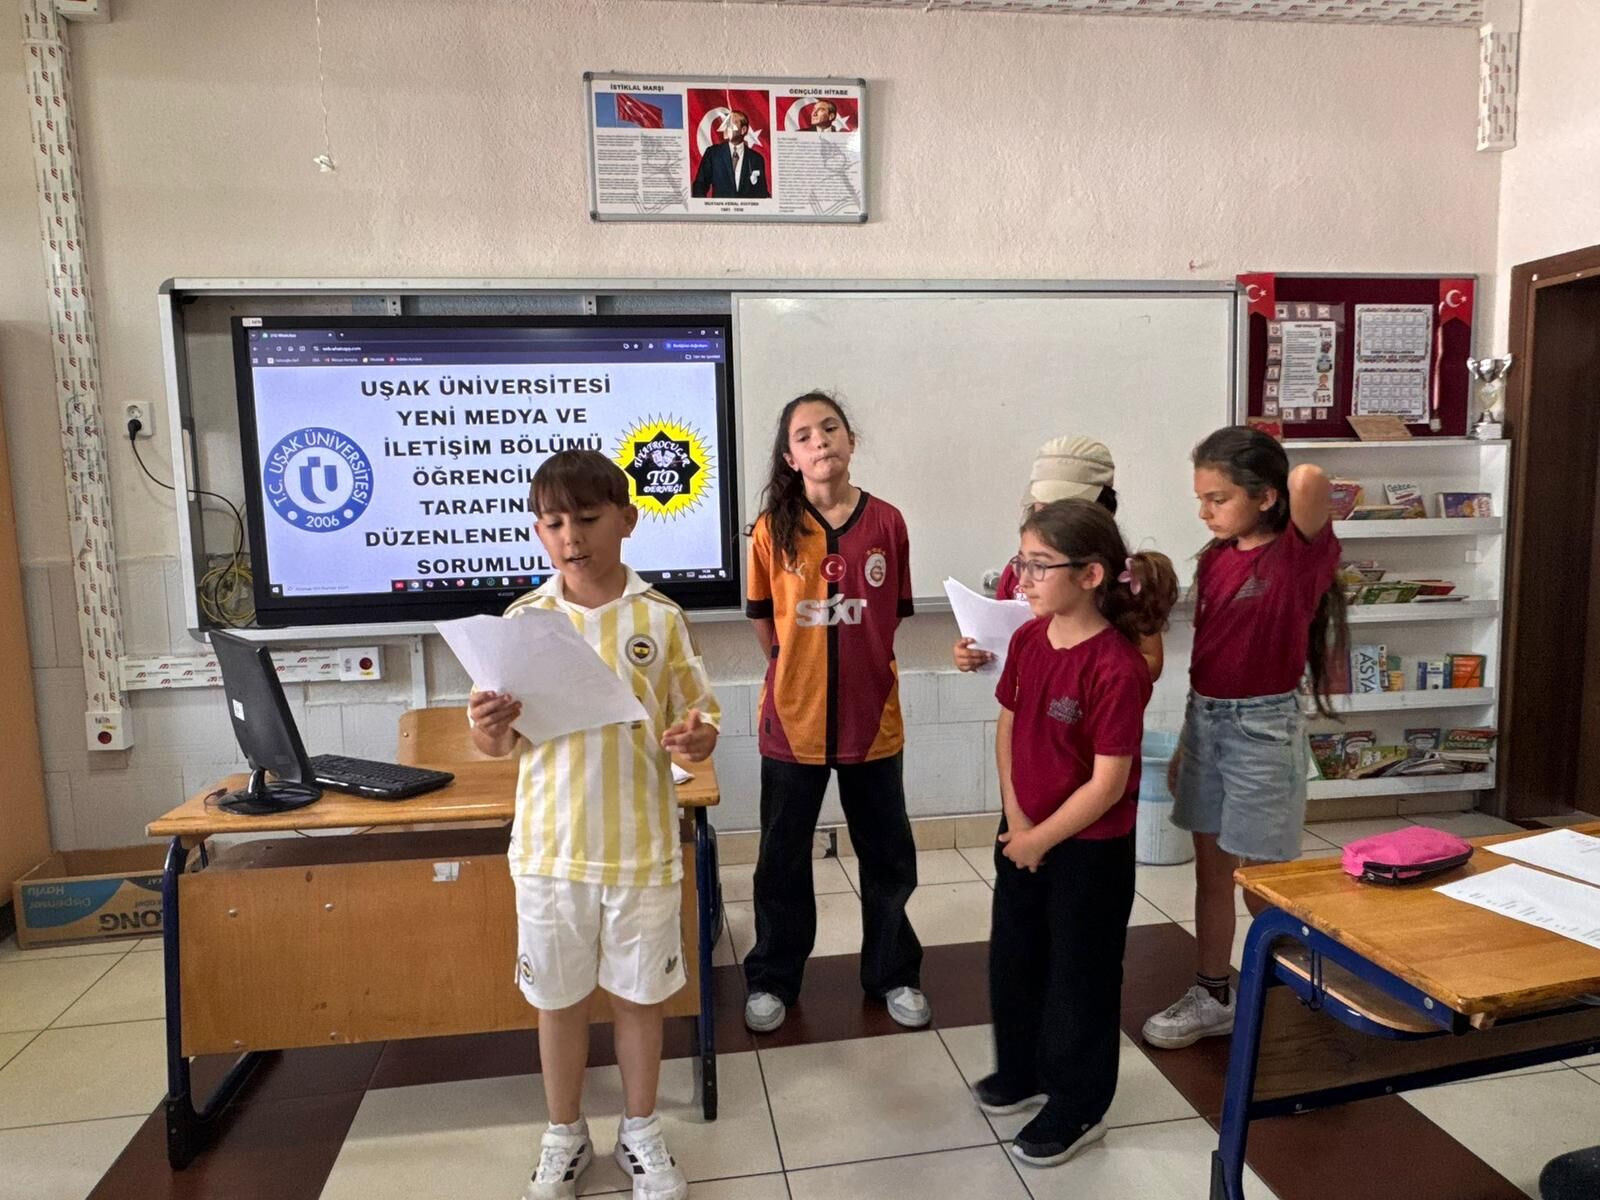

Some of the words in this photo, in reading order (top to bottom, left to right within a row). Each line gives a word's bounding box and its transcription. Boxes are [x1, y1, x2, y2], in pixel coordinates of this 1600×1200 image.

[610, 83, 640, 91] İSTİKLAL
[643, 84, 664, 93] MARŞI
[789, 87, 823, 96] GENÇLİĞE
[360, 379, 430, 400] UŞAK
[439, 374, 611, 395] ÜNİVERSİTESİ
[396, 406, 456, 426] YENİ
[465, 408, 548, 425] MEDYA
[556, 408, 587, 423] VE
[268, 436, 304, 474] UŞAK
[384, 435, 491, 460] İLETİŞİM
[500, 432, 602, 454] BÖLÜMÜ
[304, 429, 371, 506] ÜNİVERSİTESİ
[268, 480, 288, 507] T.C.
[305, 515, 340, 528] 2006
[365, 527, 530, 547] DÜZENLENEN
[417, 555, 557, 574] SORUMLUL
[1359, 652, 1376, 694] ASYA
